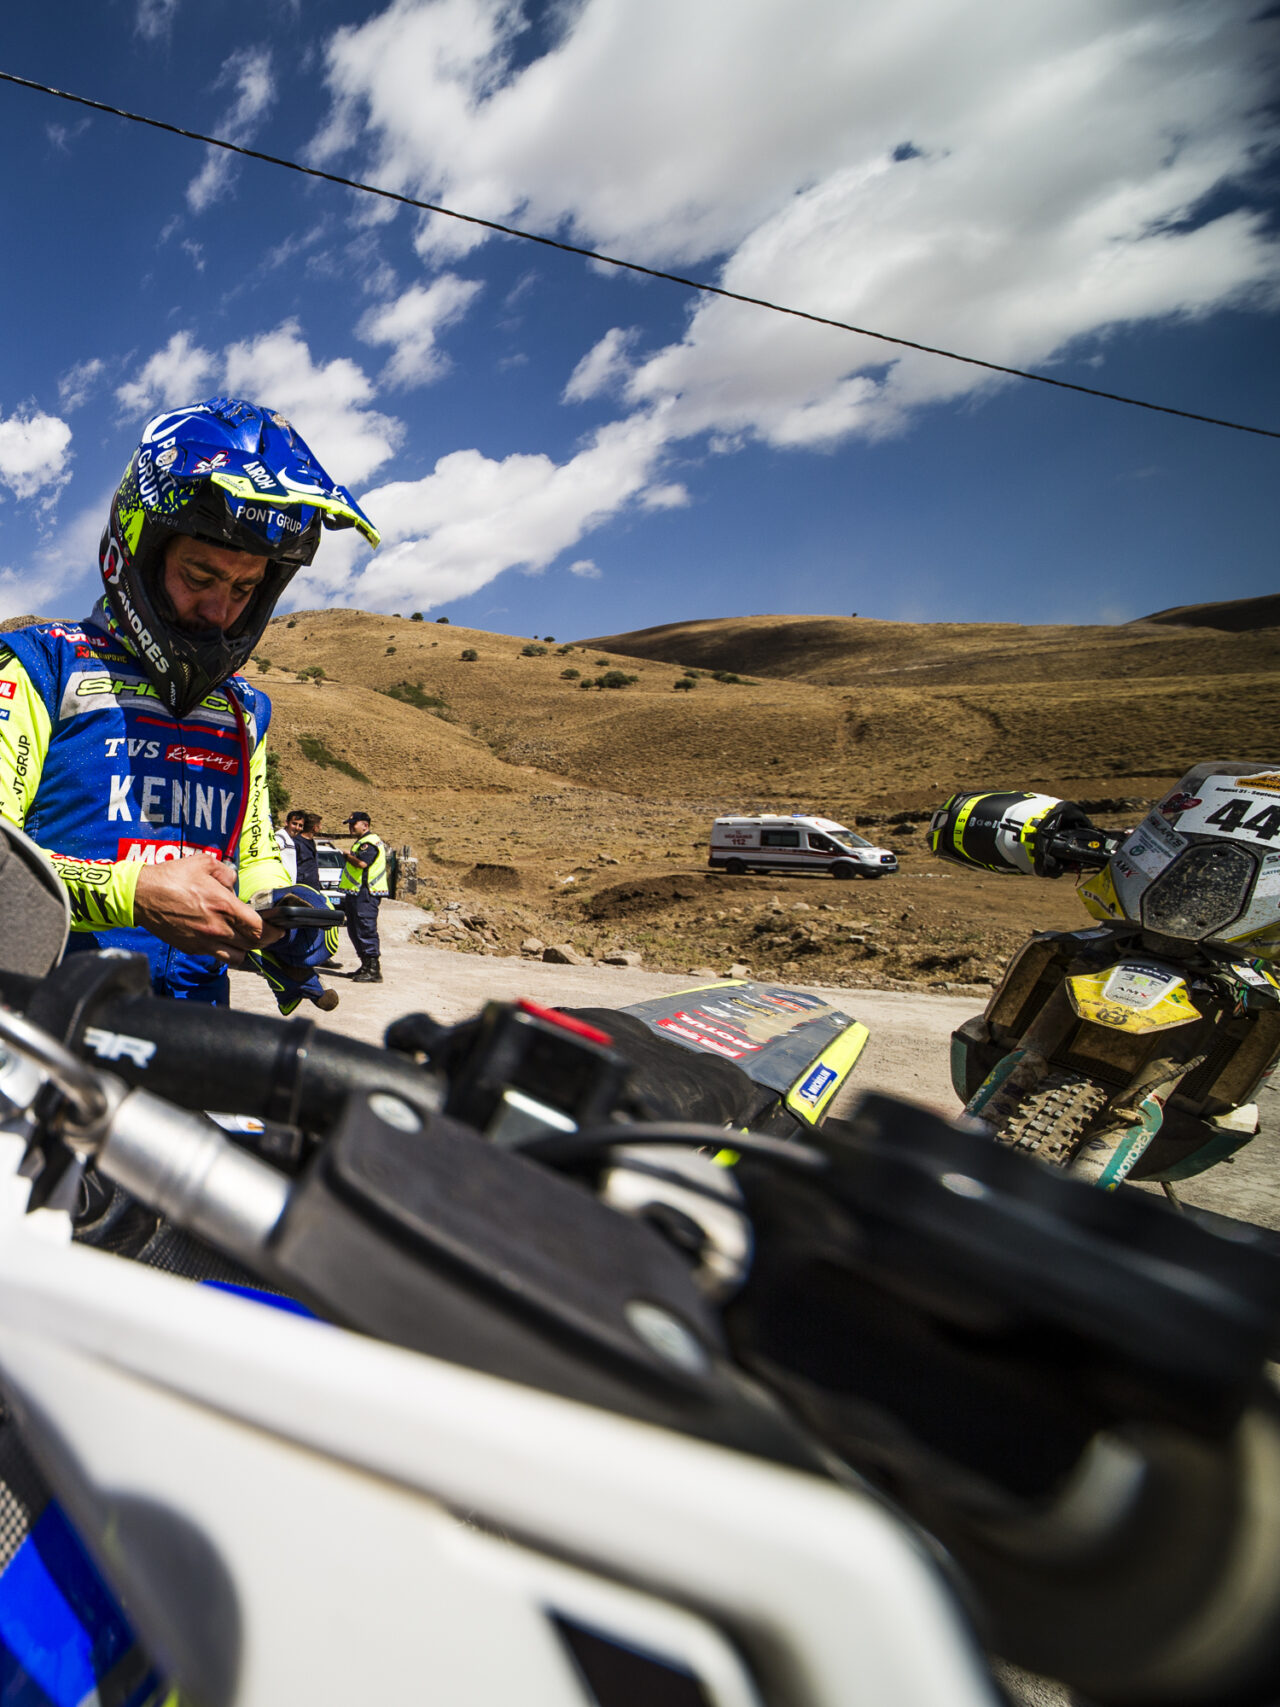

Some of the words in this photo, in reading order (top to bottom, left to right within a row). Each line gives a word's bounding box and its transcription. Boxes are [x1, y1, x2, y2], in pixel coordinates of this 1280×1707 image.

[138, 449, 159, 507] GRUP
[242, 461, 277, 490] AIROH
[235, 505, 276, 524] PONT
[276, 513, 303, 534] GRUP
[117, 590, 171, 673] ANDRES
[16, 736, 30, 777] GRUP
[104, 737, 160, 759] TVS
[167, 746, 239, 770] Racing
[107, 775, 235, 835] KENNY
[1113, 1129, 1155, 1182] MOTOREX
